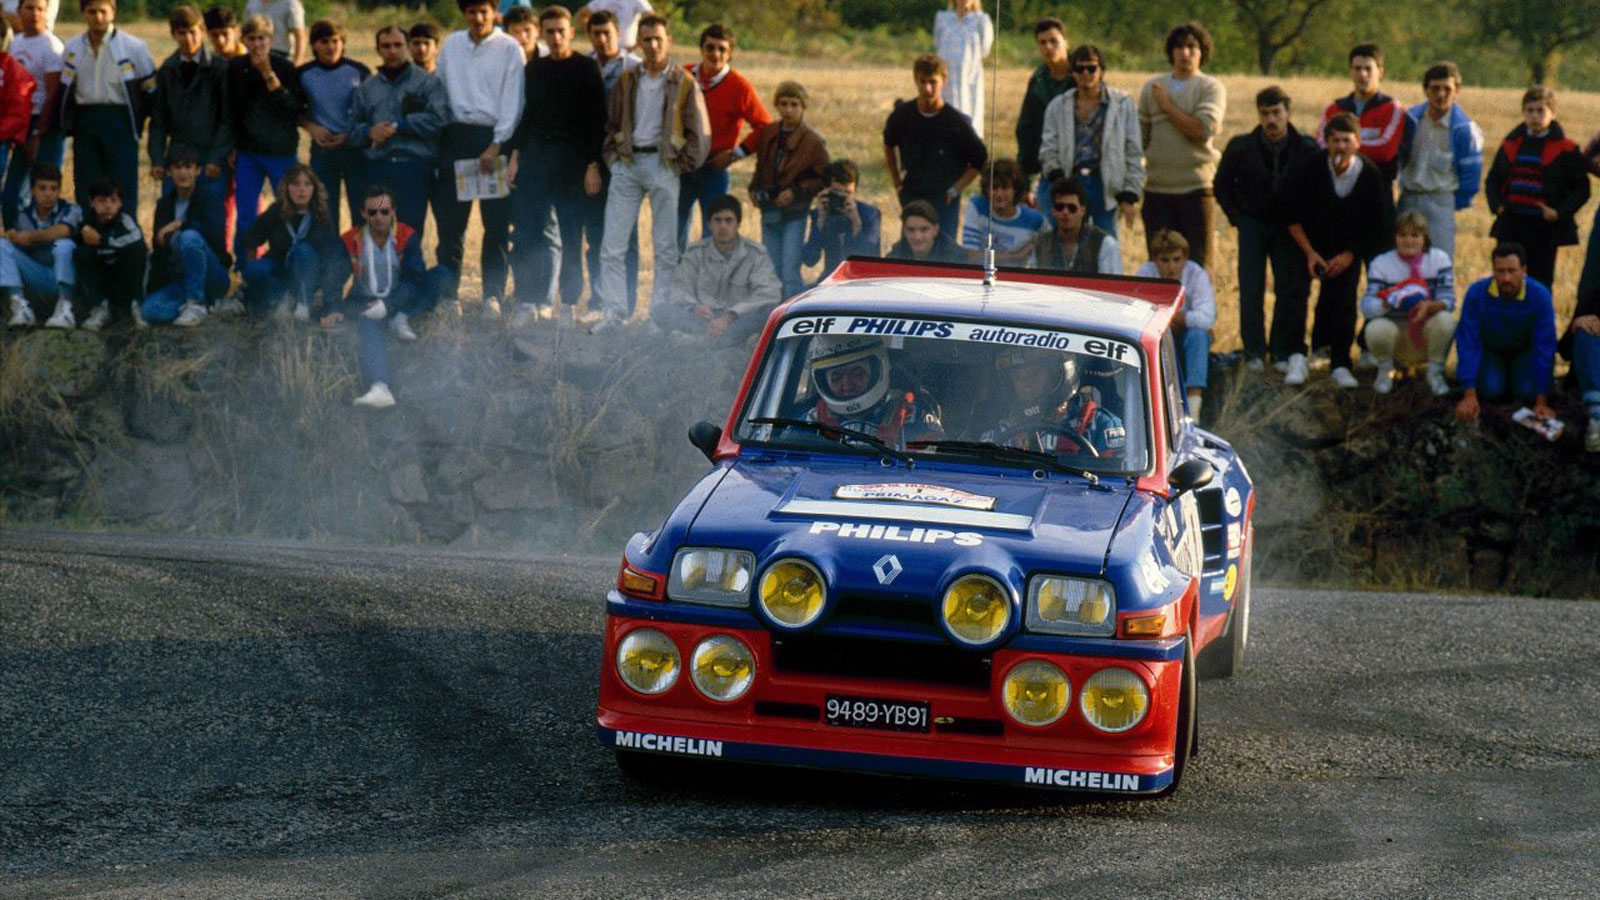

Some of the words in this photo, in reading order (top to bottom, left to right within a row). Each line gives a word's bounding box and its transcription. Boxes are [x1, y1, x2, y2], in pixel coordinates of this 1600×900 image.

[792, 318, 836, 334] elf
[846, 318, 955, 338] PHILIPS
[969, 328, 1070, 350] autoradio
[1083, 340, 1128, 361] elf
[808, 521, 984, 546] PHILIPS
[615, 730, 723, 757] MICHELIN
[1024, 767, 1140, 791] MICHELIN
